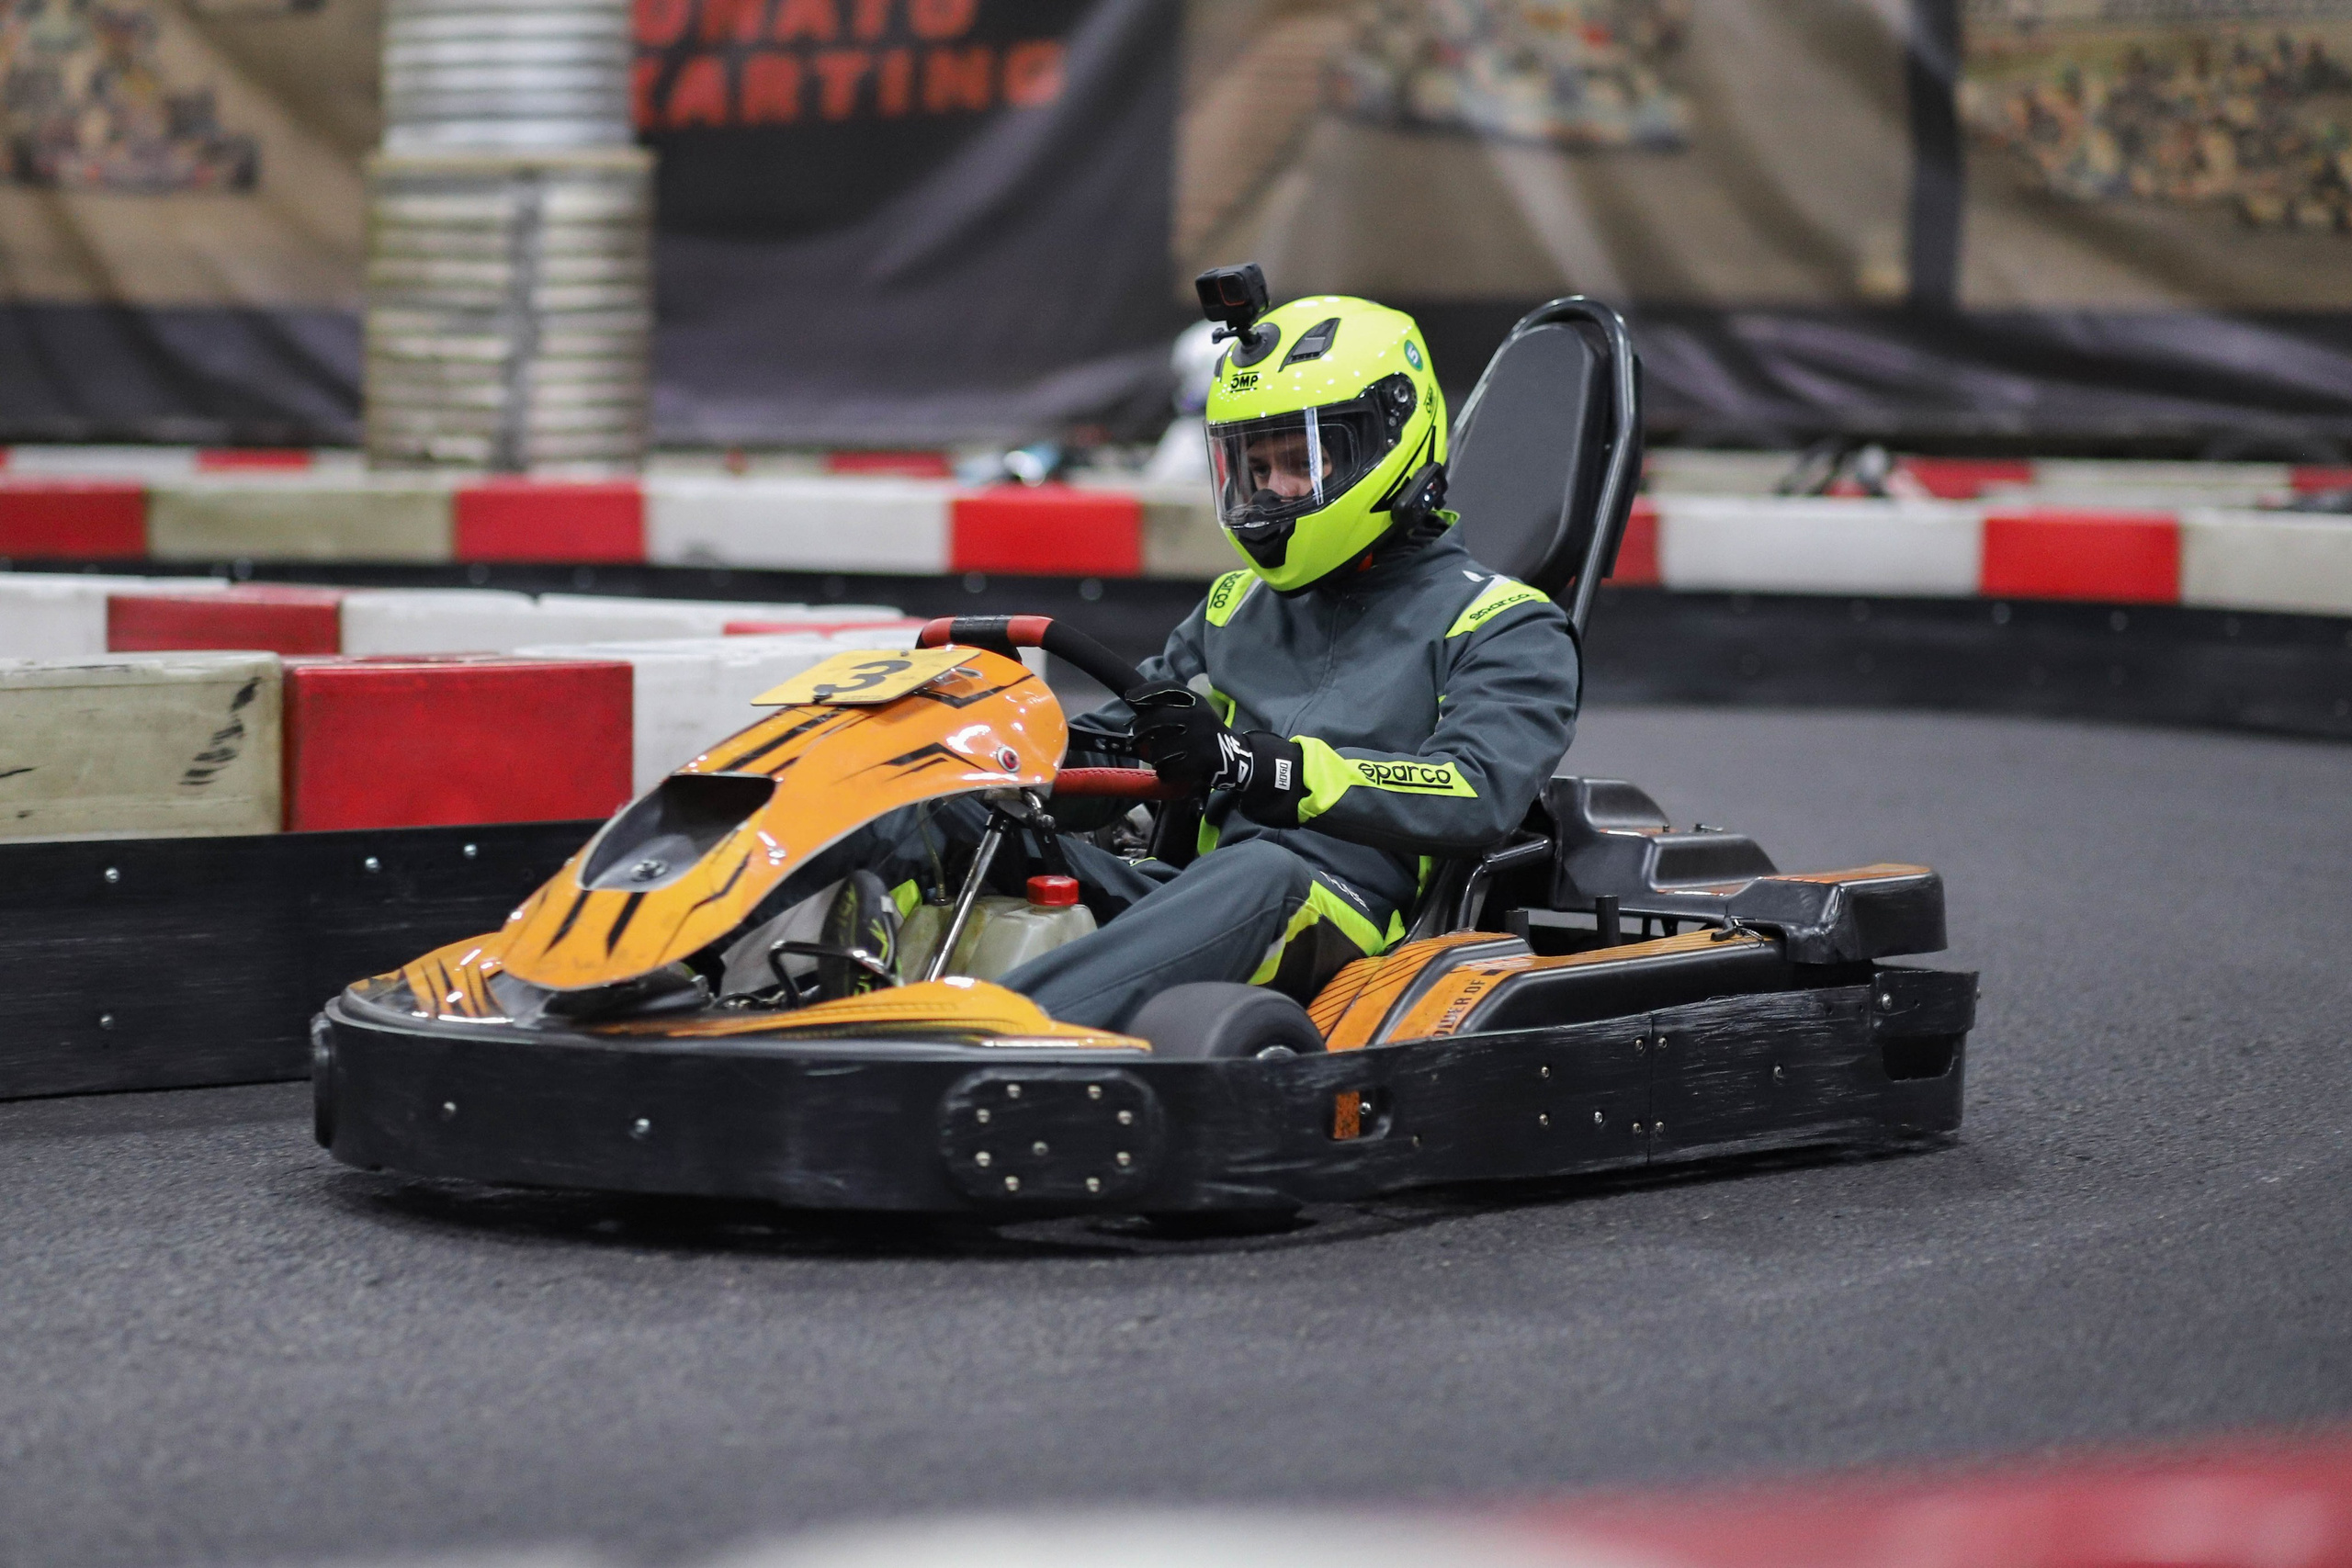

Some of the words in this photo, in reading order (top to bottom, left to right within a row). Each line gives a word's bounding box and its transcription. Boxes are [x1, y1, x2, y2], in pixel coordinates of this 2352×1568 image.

[1230, 373, 1260, 390] OMP
[1469, 592, 1531, 620] sparco
[812, 660, 913, 694] 3
[1357, 762, 1453, 787] sparco
